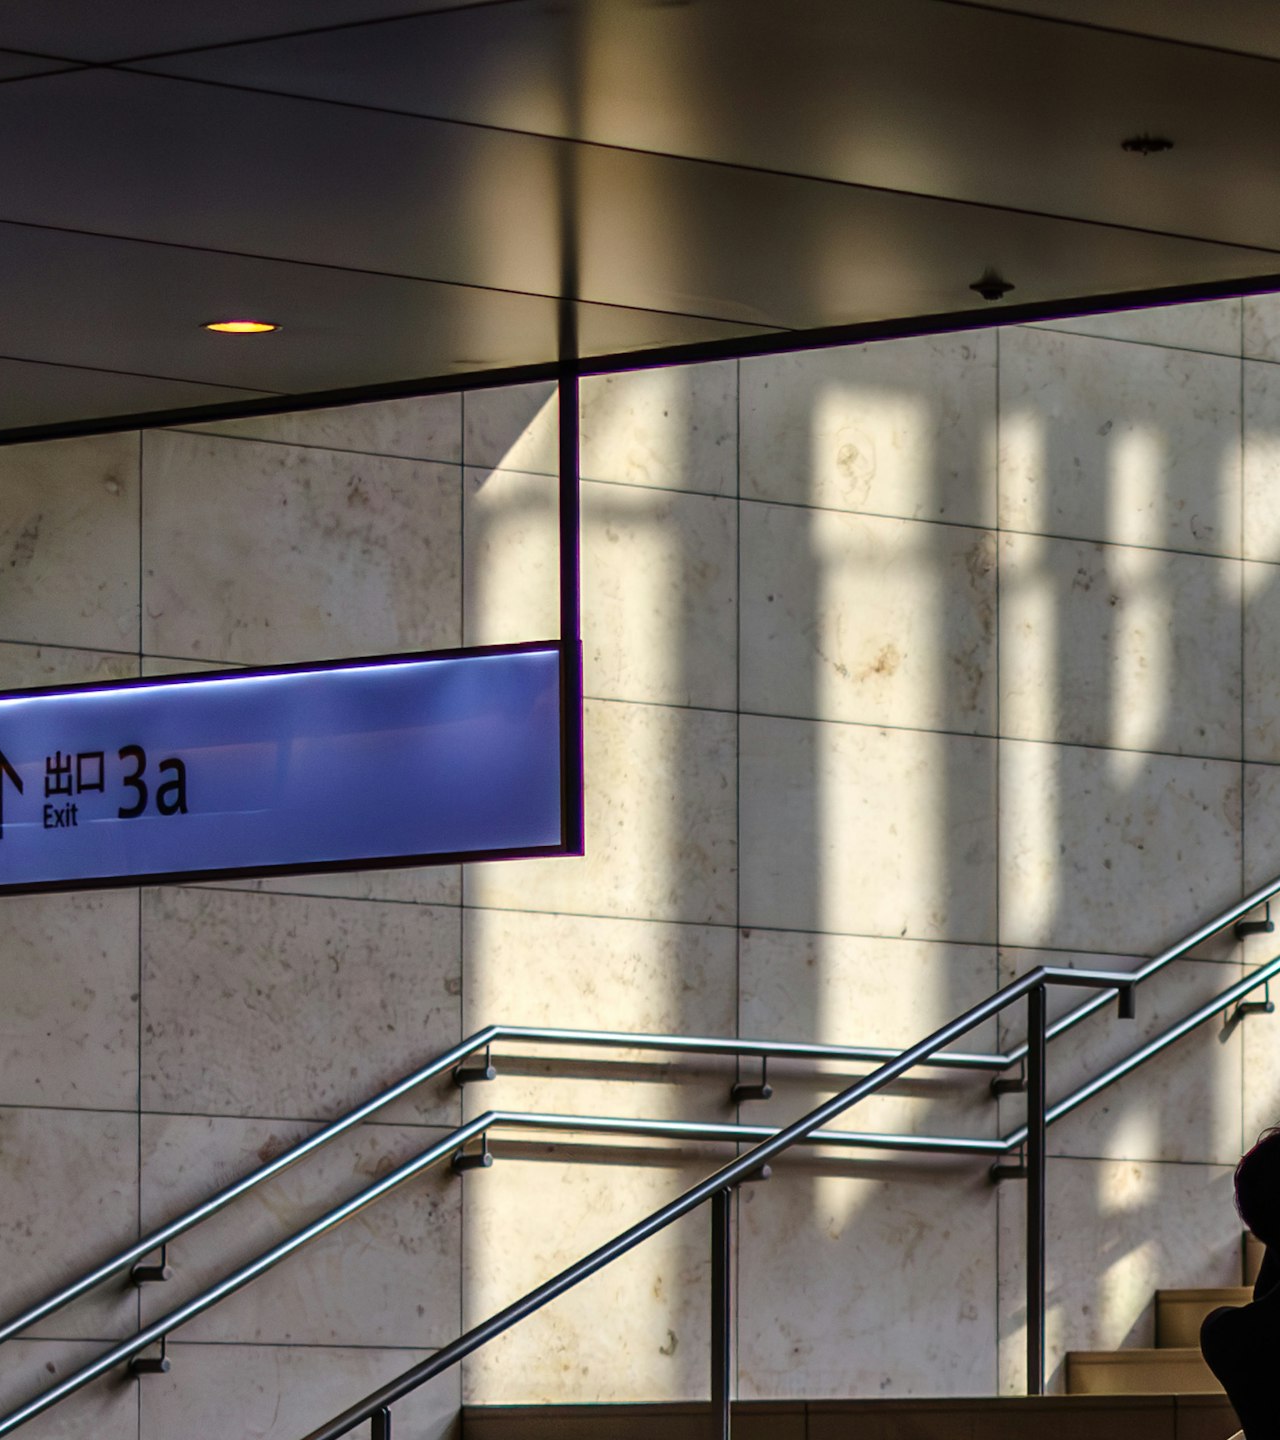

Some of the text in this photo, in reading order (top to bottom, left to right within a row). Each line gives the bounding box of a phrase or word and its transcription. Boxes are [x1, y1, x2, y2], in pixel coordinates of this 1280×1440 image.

[44, 744, 188, 819] 出口 3a
[43, 802, 78, 829] Exit
